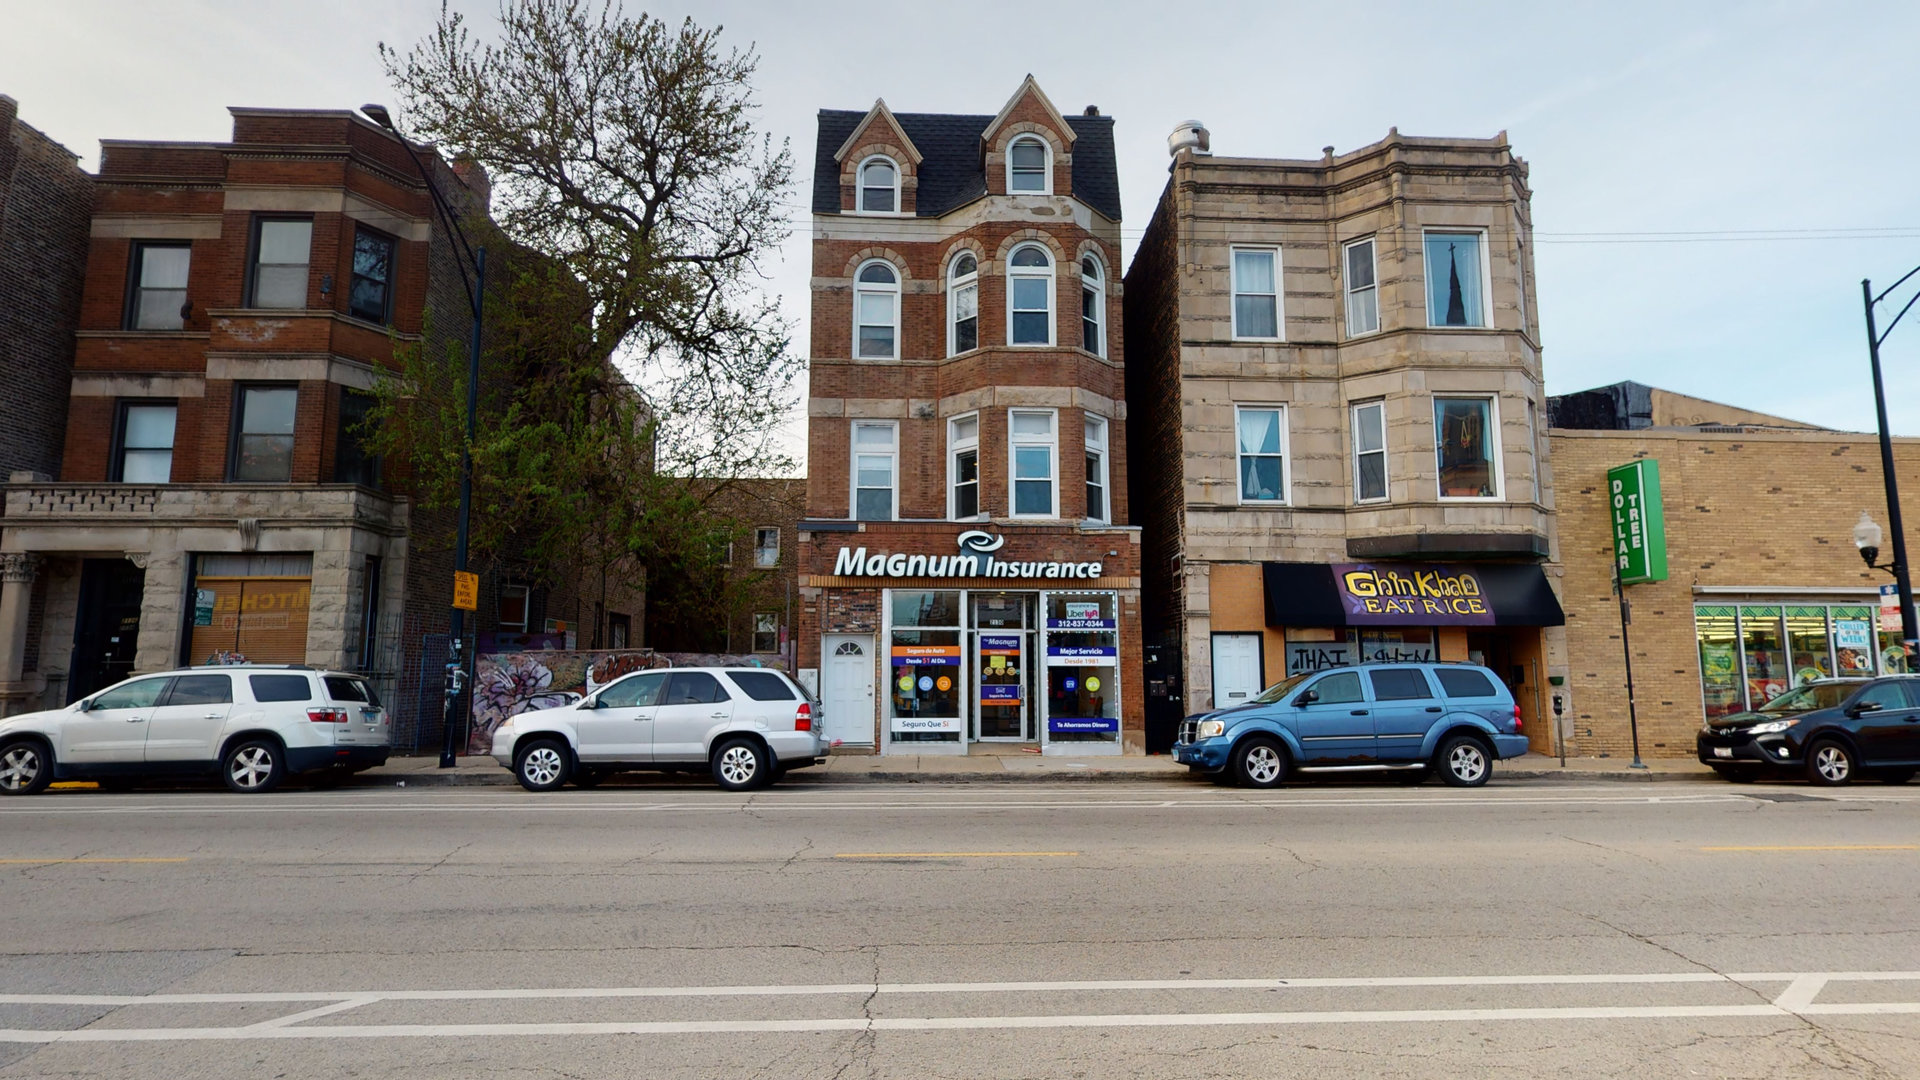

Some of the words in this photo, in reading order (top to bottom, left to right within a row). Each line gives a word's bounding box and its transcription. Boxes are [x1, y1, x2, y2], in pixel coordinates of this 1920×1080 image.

[1612, 479, 1629, 570] DOLLAR
[1628, 494, 1641, 549] TREE
[834, 547, 979, 577] Magnum
[985, 556, 1102, 579] Insurance
[1067, 610, 1084, 618] Uber
[1085, 609, 1098, 619] lyft
[1365, 598, 1415, 613] EAT
[1421, 598, 1487, 614] RICE
[1060, 647, 1077, 655] Mejor
[1078, 647, 1103, 655] Servicio
[1294, 649, 1349, 670] THAI
[902, 720, 926, 729] Seguro
